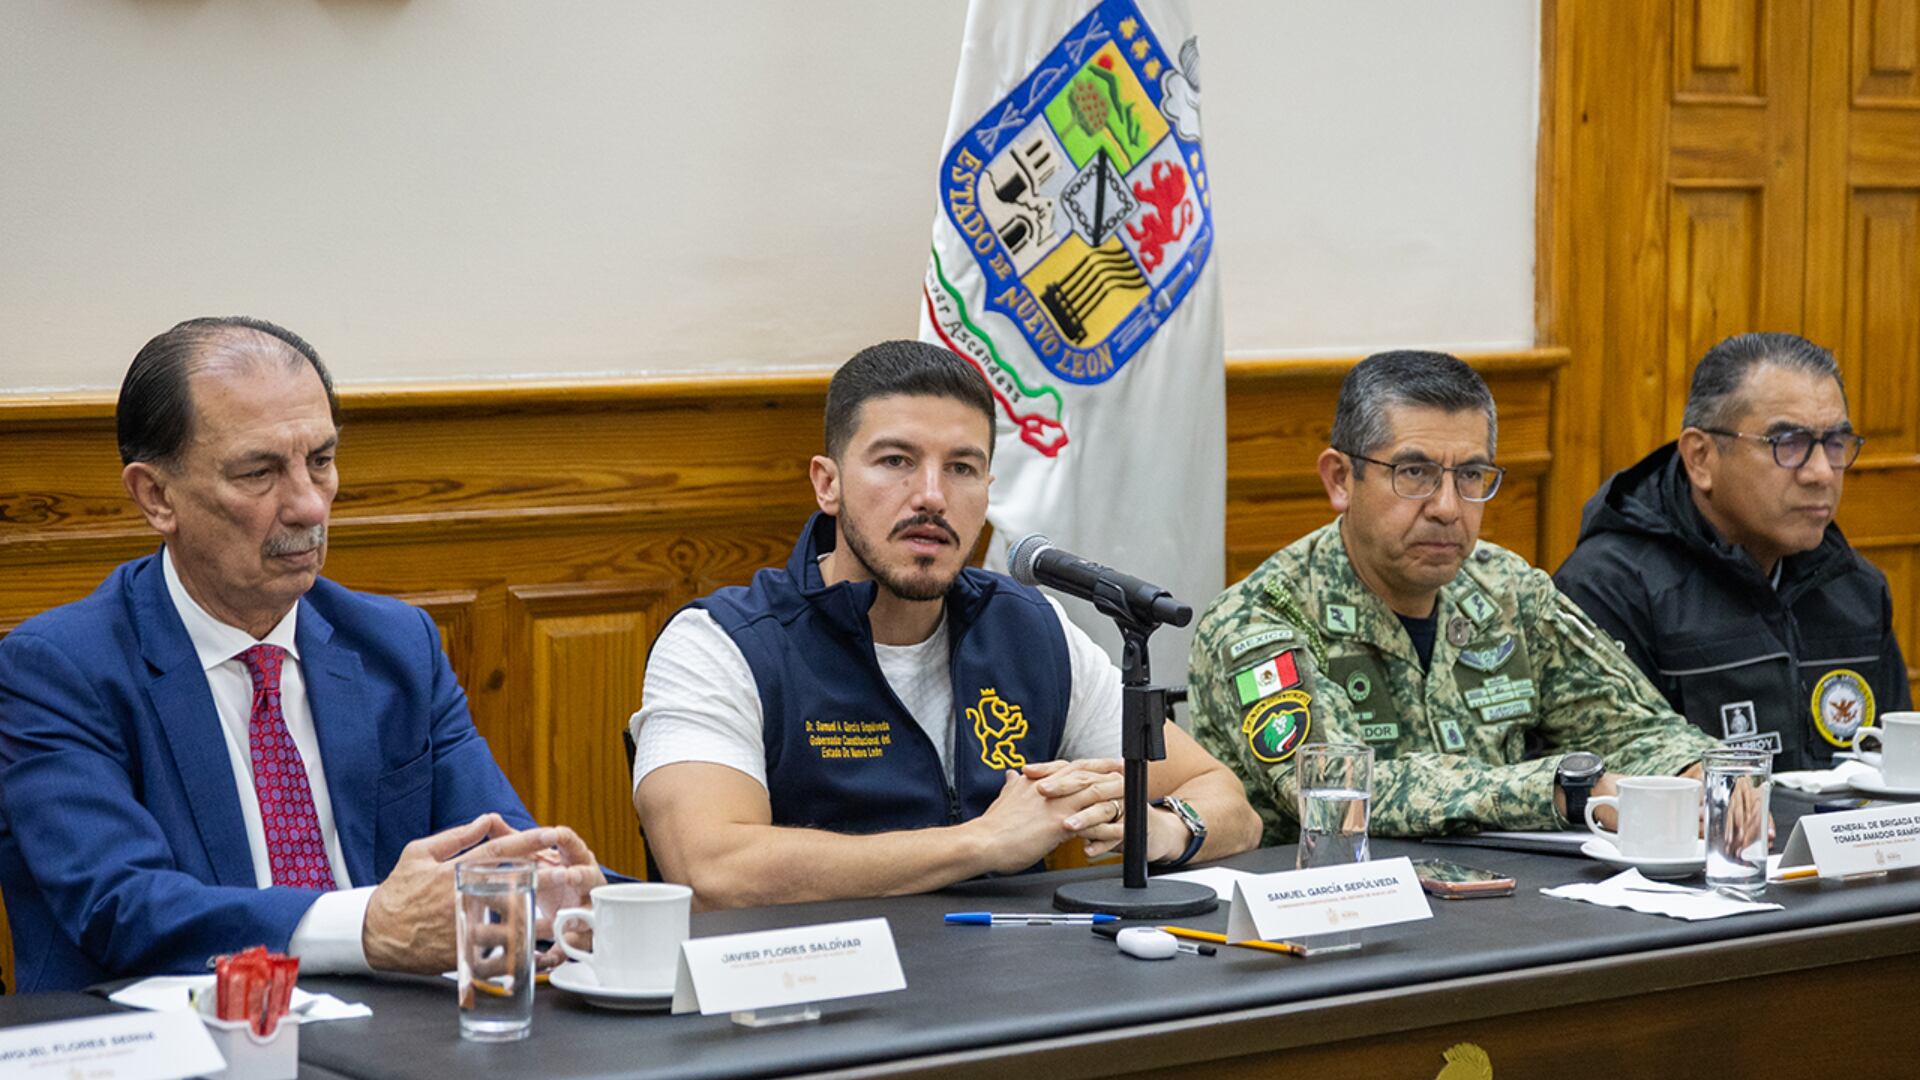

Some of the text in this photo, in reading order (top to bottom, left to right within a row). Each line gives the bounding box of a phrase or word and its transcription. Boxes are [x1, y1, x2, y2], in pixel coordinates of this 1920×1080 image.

[949, 147, 995, 254] ESTADO
[990, 252, 1012, 280] DE
[994, 286, 1059, 356] NUEVO
[1364, 726, 1392, 737] DOR
[1831, 816, 1920, 833] GENERAL DE BRIGADA E
[1863, 830, 1895, 840] AMADOR
[1896, 826, 1920, 836] RAMÍR
[1267, 889, 1306, 902] SAMUEL
[1307, 883, 1343, 897] GARCÍA
[1344, 877, 1400, 893] SEPÚLVEDA
[721, 951, 760, 964] JAVIER
[763, 945, 807, 959] FLORES
[810, 937, 861, 952] SALDÍVAR
